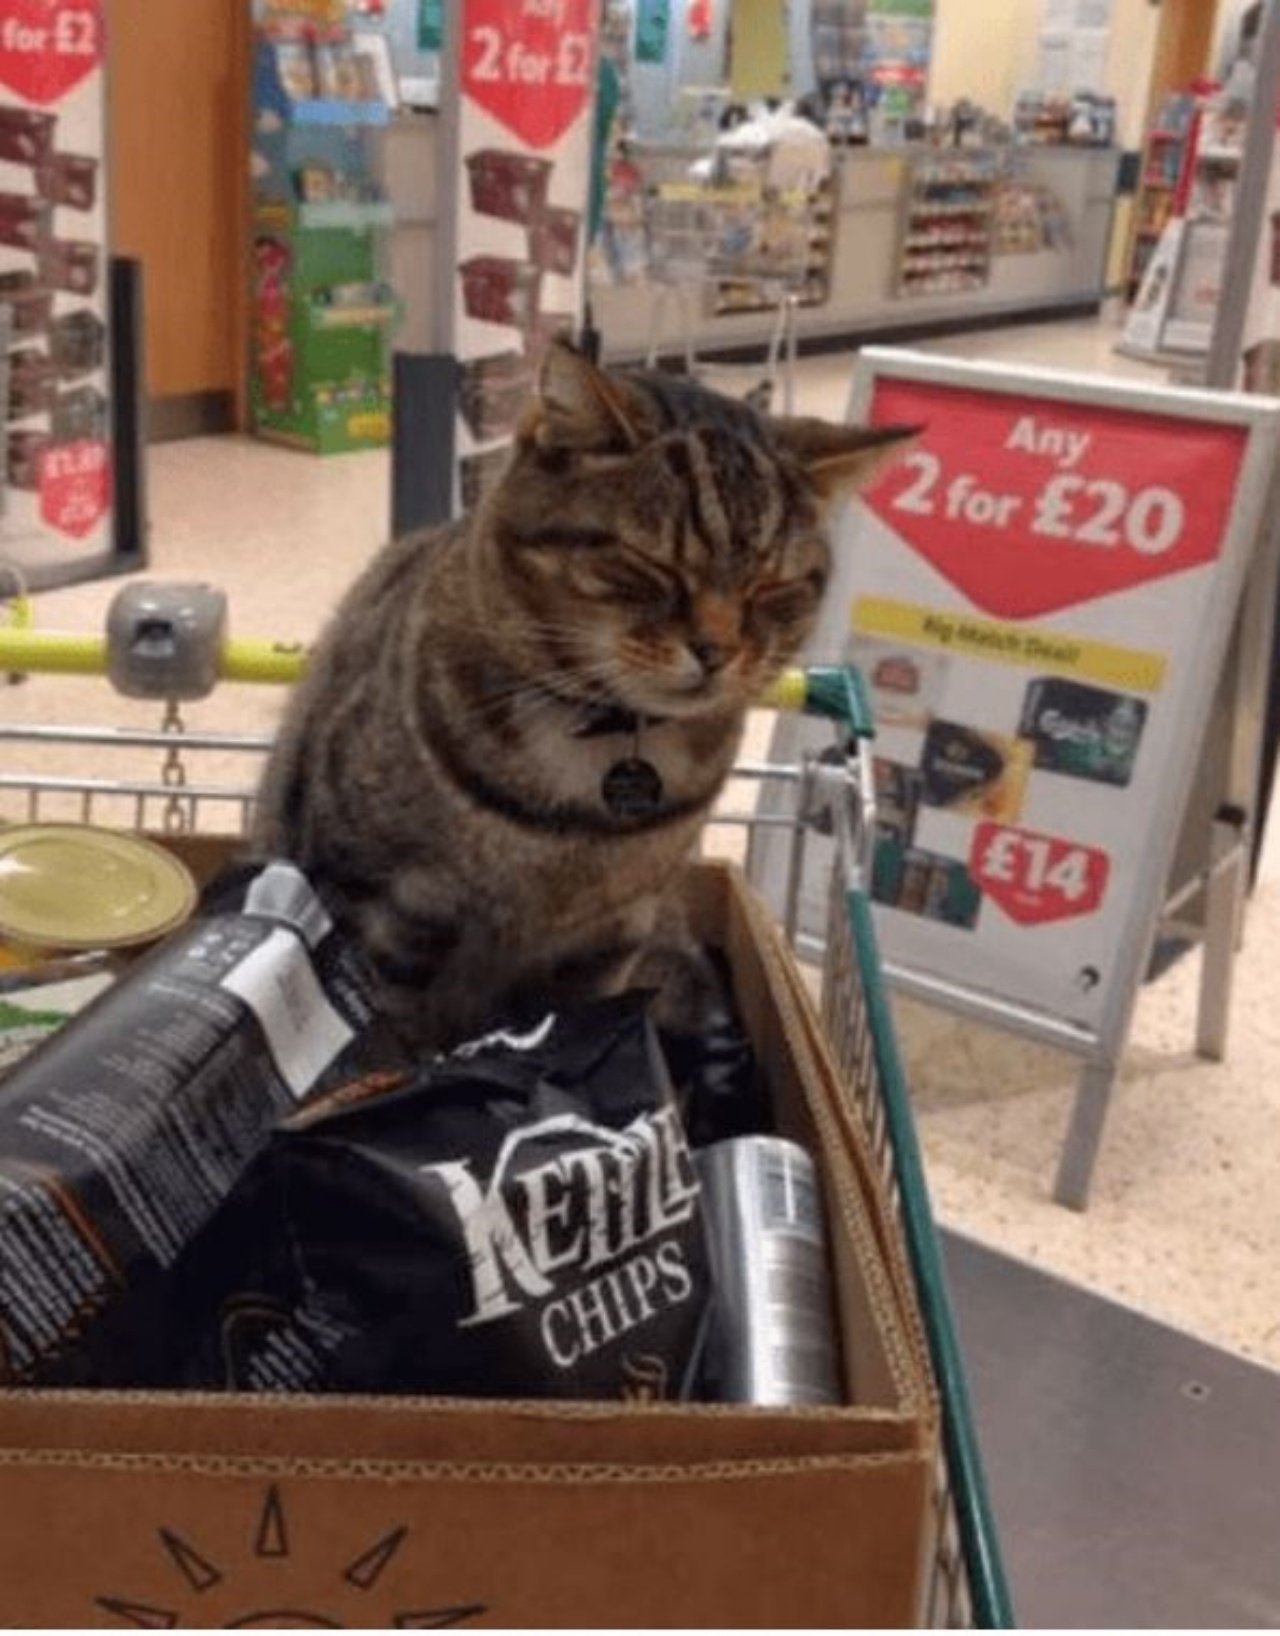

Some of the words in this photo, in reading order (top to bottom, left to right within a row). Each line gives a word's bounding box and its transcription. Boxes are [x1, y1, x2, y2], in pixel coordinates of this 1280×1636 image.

[3, 16, 47, 53] for
[55, 8, 96, 56] £2
[471, 25, 501, 80] 2
[506, 41, 553, 86] for
[1004, 415, 1092, 468] Any
[892, 451, 941, 515] 2
[944, 473, 1022, 528] for
[1030, 474, 1185, 555] £20
[980, 830, 1089, 901] £14
[418, 1104, 702, 1328] KETTLE
[540, 1240, 693, 1367] CHIPS
